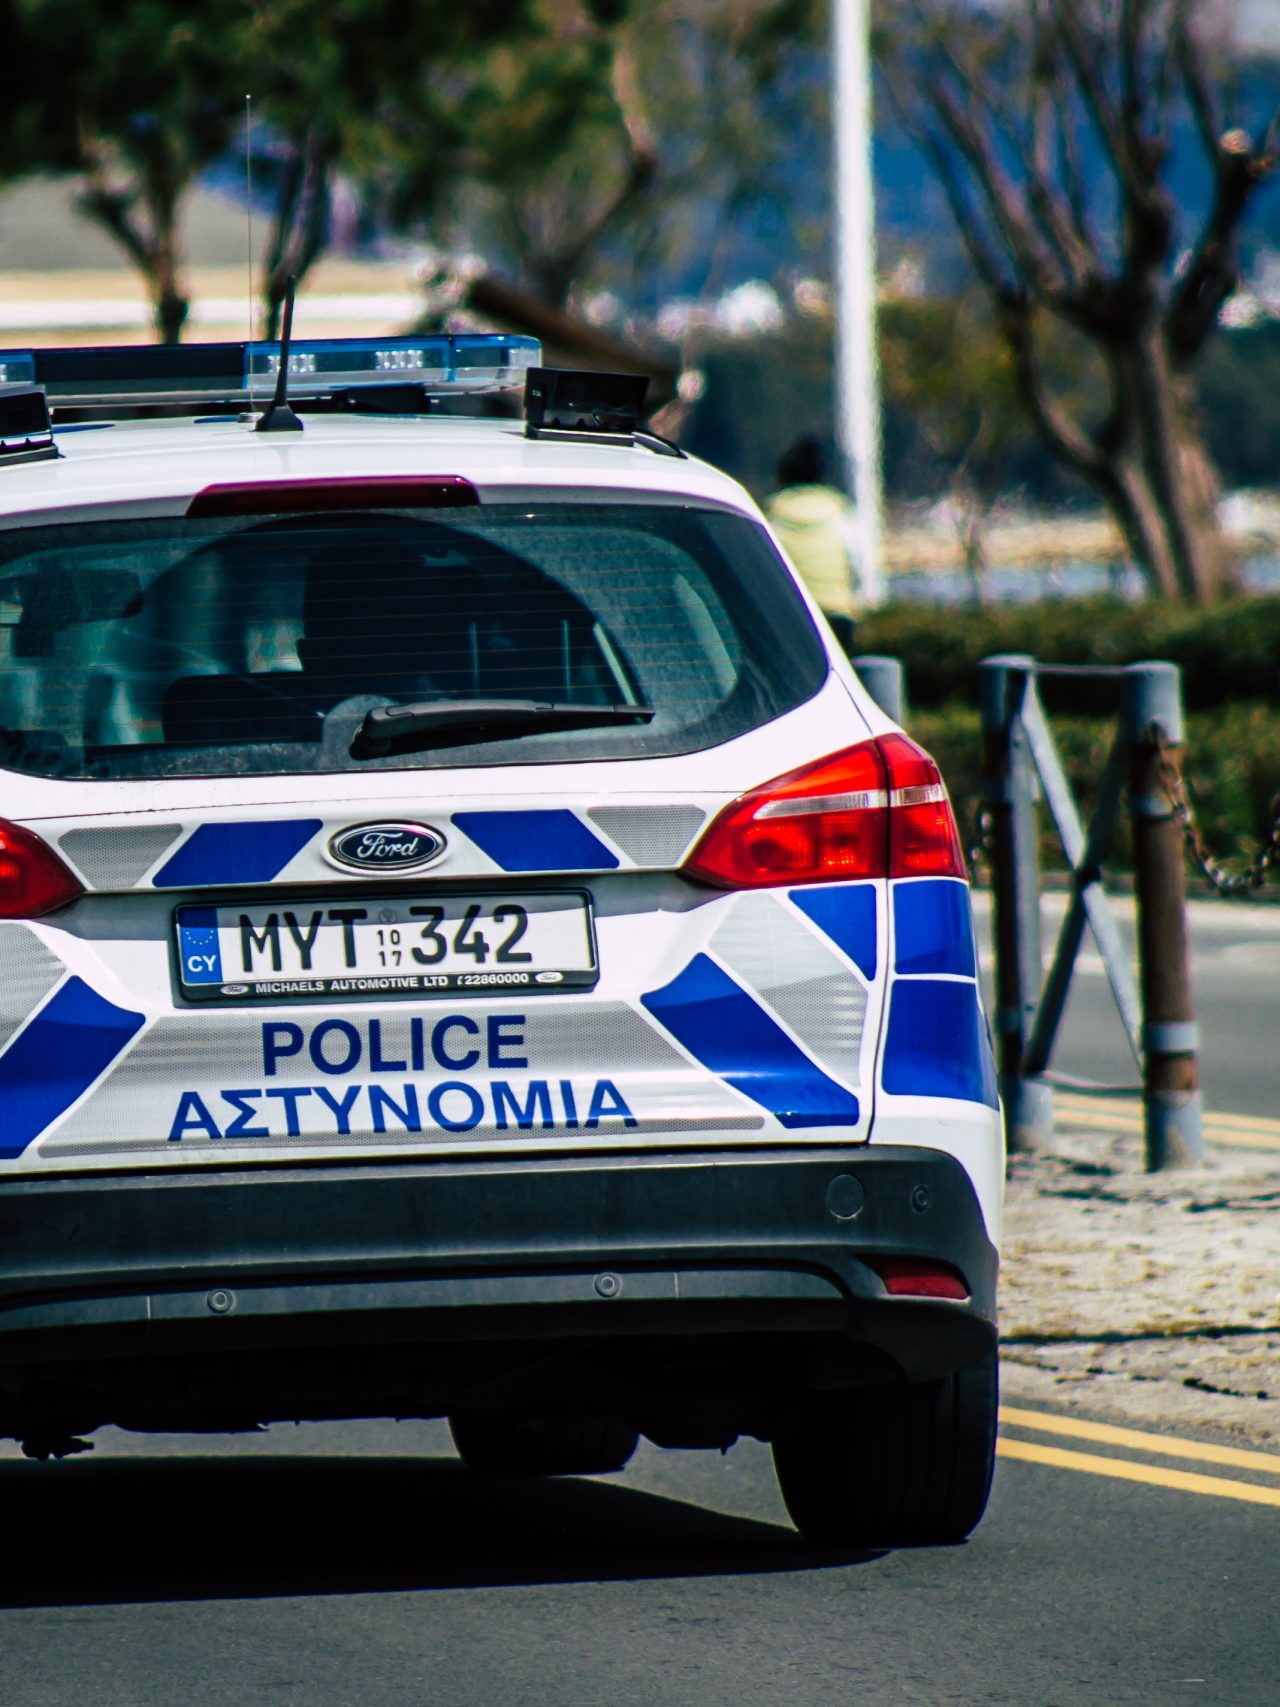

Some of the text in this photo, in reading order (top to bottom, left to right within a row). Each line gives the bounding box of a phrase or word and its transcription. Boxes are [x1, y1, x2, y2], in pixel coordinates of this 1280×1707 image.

[357, 831, 419, 858] Ford
[239, 904, 533, 973] MYT 342
[376, 929, 401, 946] 10
[187, 955, 217, 973] CY
[377, 950, 402, 967] 17
[255, 980, 324, 994] MICHAELS
[330, 976, 419, 991] AUTOMOTIVE
[424, 975, 449, 988] LTD
[262, 1014, 528, 1076] POLICE
[167, 1078, 639, 1142] ΑΣΤΥΝΟΜΙΑ
